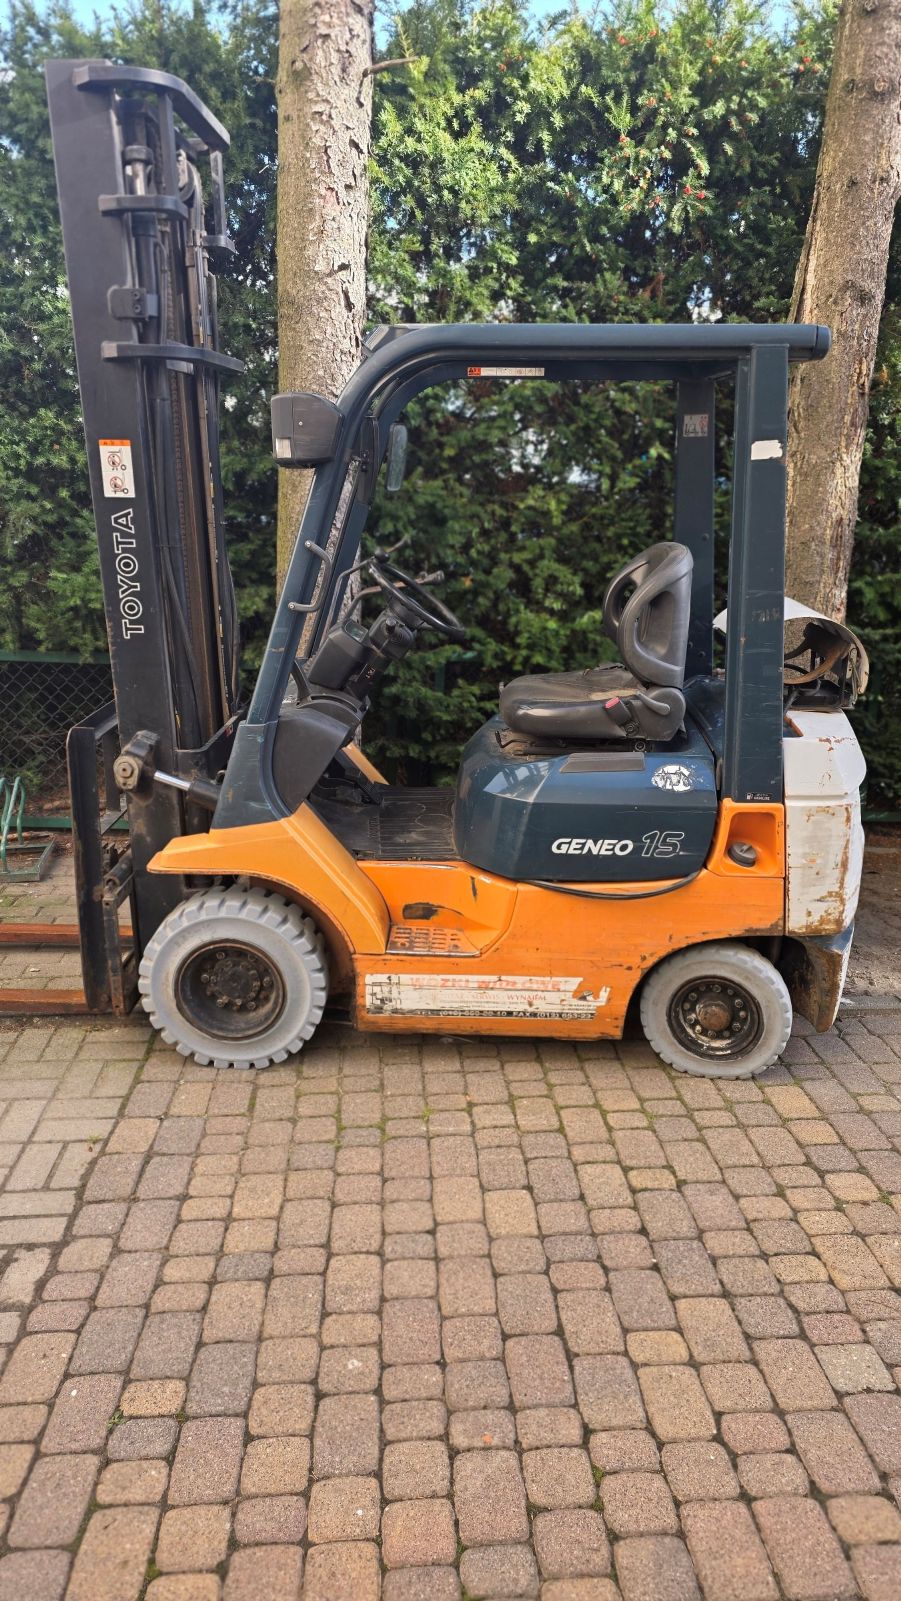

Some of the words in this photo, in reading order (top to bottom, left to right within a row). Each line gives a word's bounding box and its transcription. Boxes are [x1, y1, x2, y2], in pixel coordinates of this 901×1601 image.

[111, 508, 145, 640] TOYOTA
[551, 838, 634, 856] GENEO
[641, 830, 685, 858] 15
